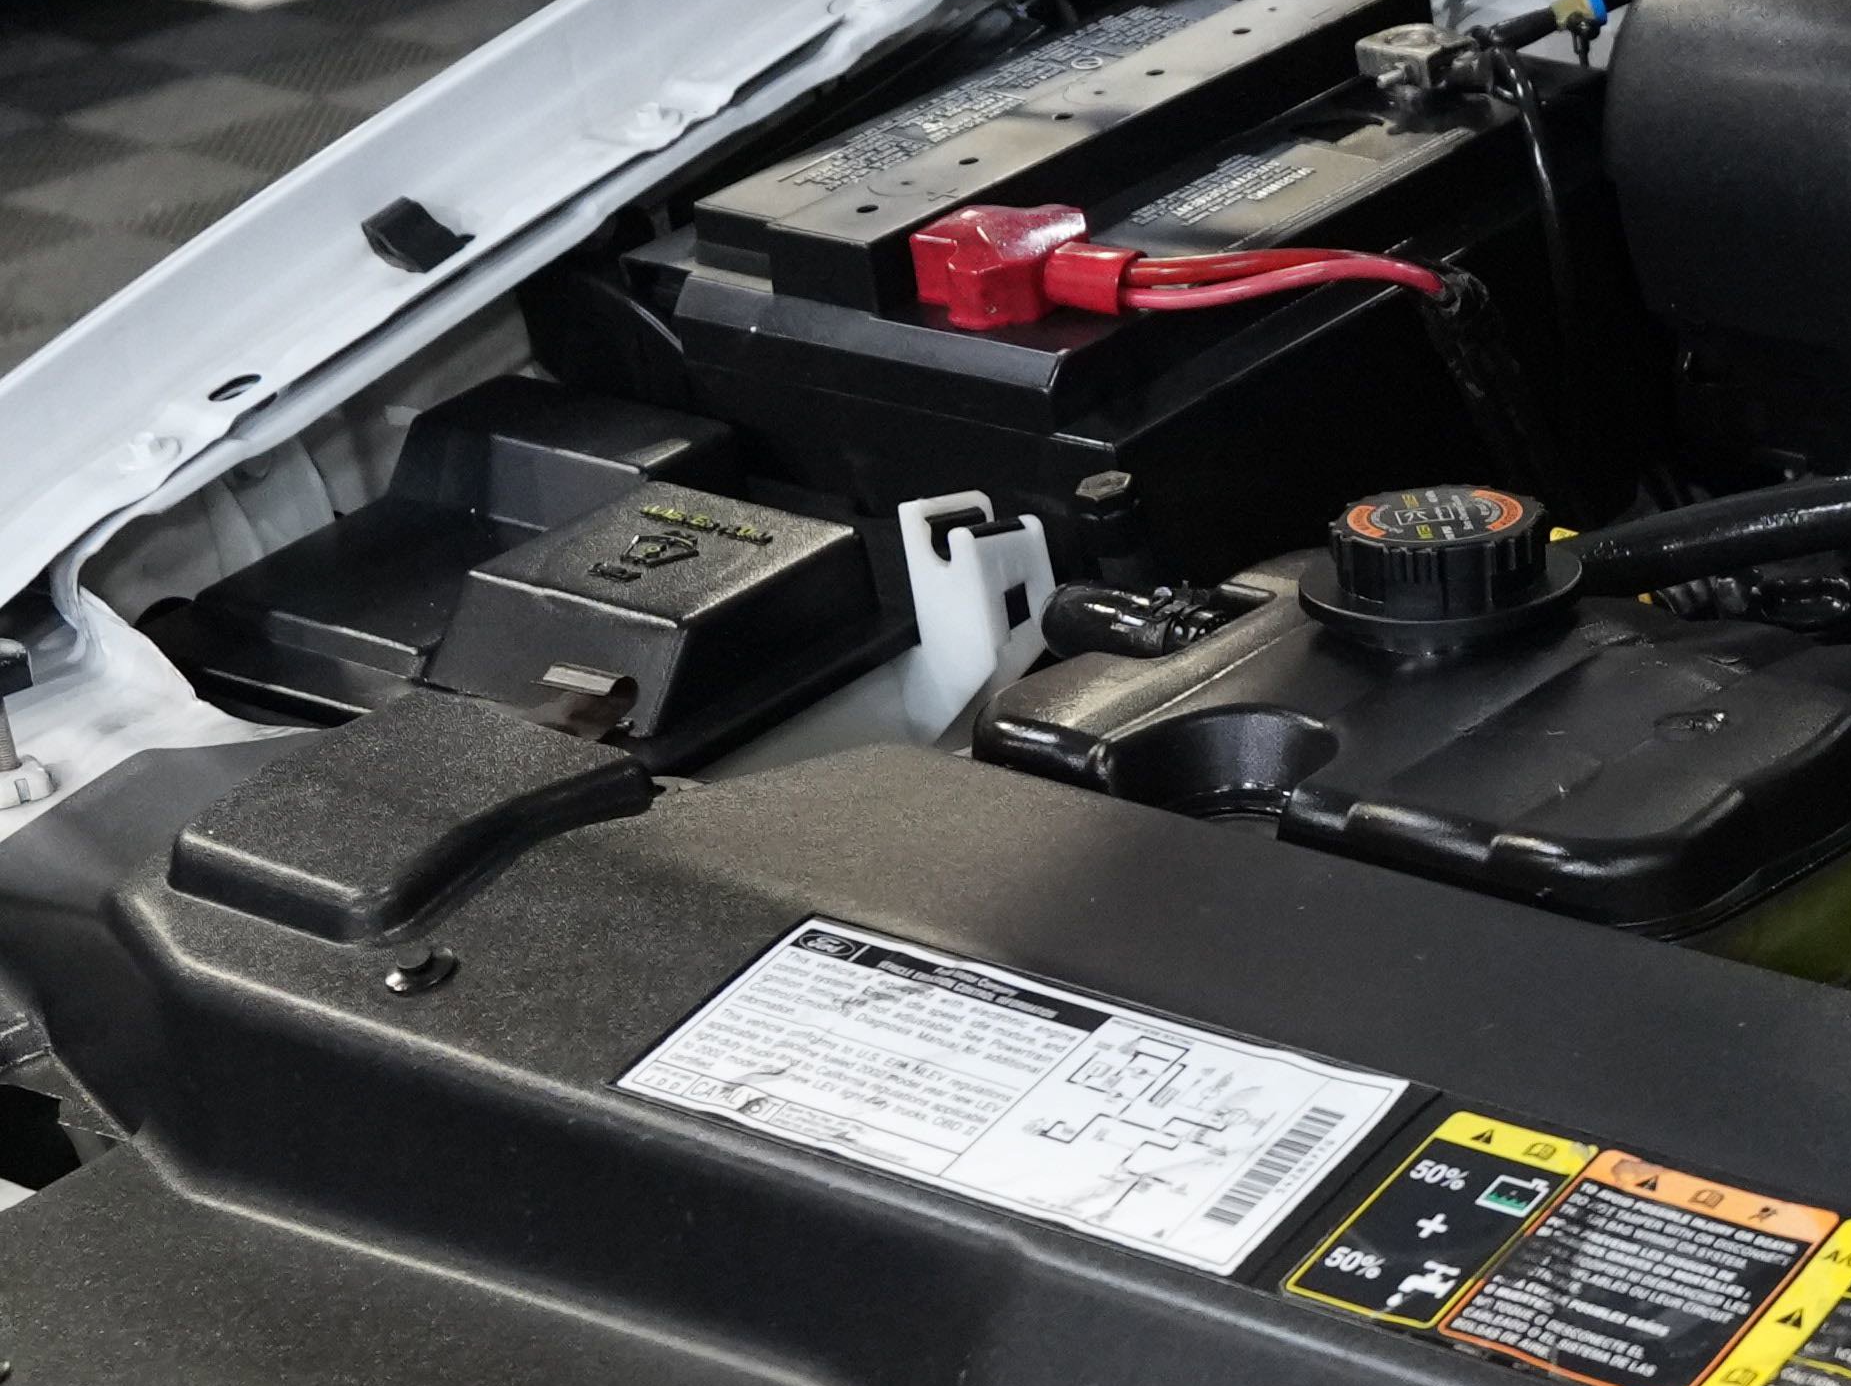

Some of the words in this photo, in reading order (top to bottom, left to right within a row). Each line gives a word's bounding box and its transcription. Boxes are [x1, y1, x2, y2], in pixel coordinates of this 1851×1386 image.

[804, 933, 850, 955] Ford
[758, 971, 806, 991] ignition
[864, 1002, 892, 1016] not
[956, 1029, 989, 1045] See
[985, 1038, 1057, 1065] Powertrain
[770, 961, 812, 978] control
[857, 986, 904, 1006] Engine
[899, 998, 928, 1013] idle
[965, 1018, 994, 1032] idle
[1041, 1040, 1068, 1054] and
[782, 950, 813, 965] This
[813, 959, 859, 978] vehicle
[937, 996, 966, 1010] with
[966, 1004, 1031, 1029] electronic
[1031, 1023, 1079, 1043] engine
[874, 959, 916, 977] VEHICLE
[951, 981, 1000, 1001] CONTROL
[992, 993, 1060, 1019] INFORMATION
[716, 1007, 746, 1022] This
[742, 1015, 786, 1034] vehicle
[837, 1044, 856, 1055] to
[879, 1056, 911, 1072] EPA
[906, 1064, 947, 1083] NLEV
[944, 1076, 1015, 1103] regulations
[685, 1077, 784, 1119] CATALYST
[1409, 1158, 1467, 1193] 50%
[1324, 1245, 1386, 1281] 50%
